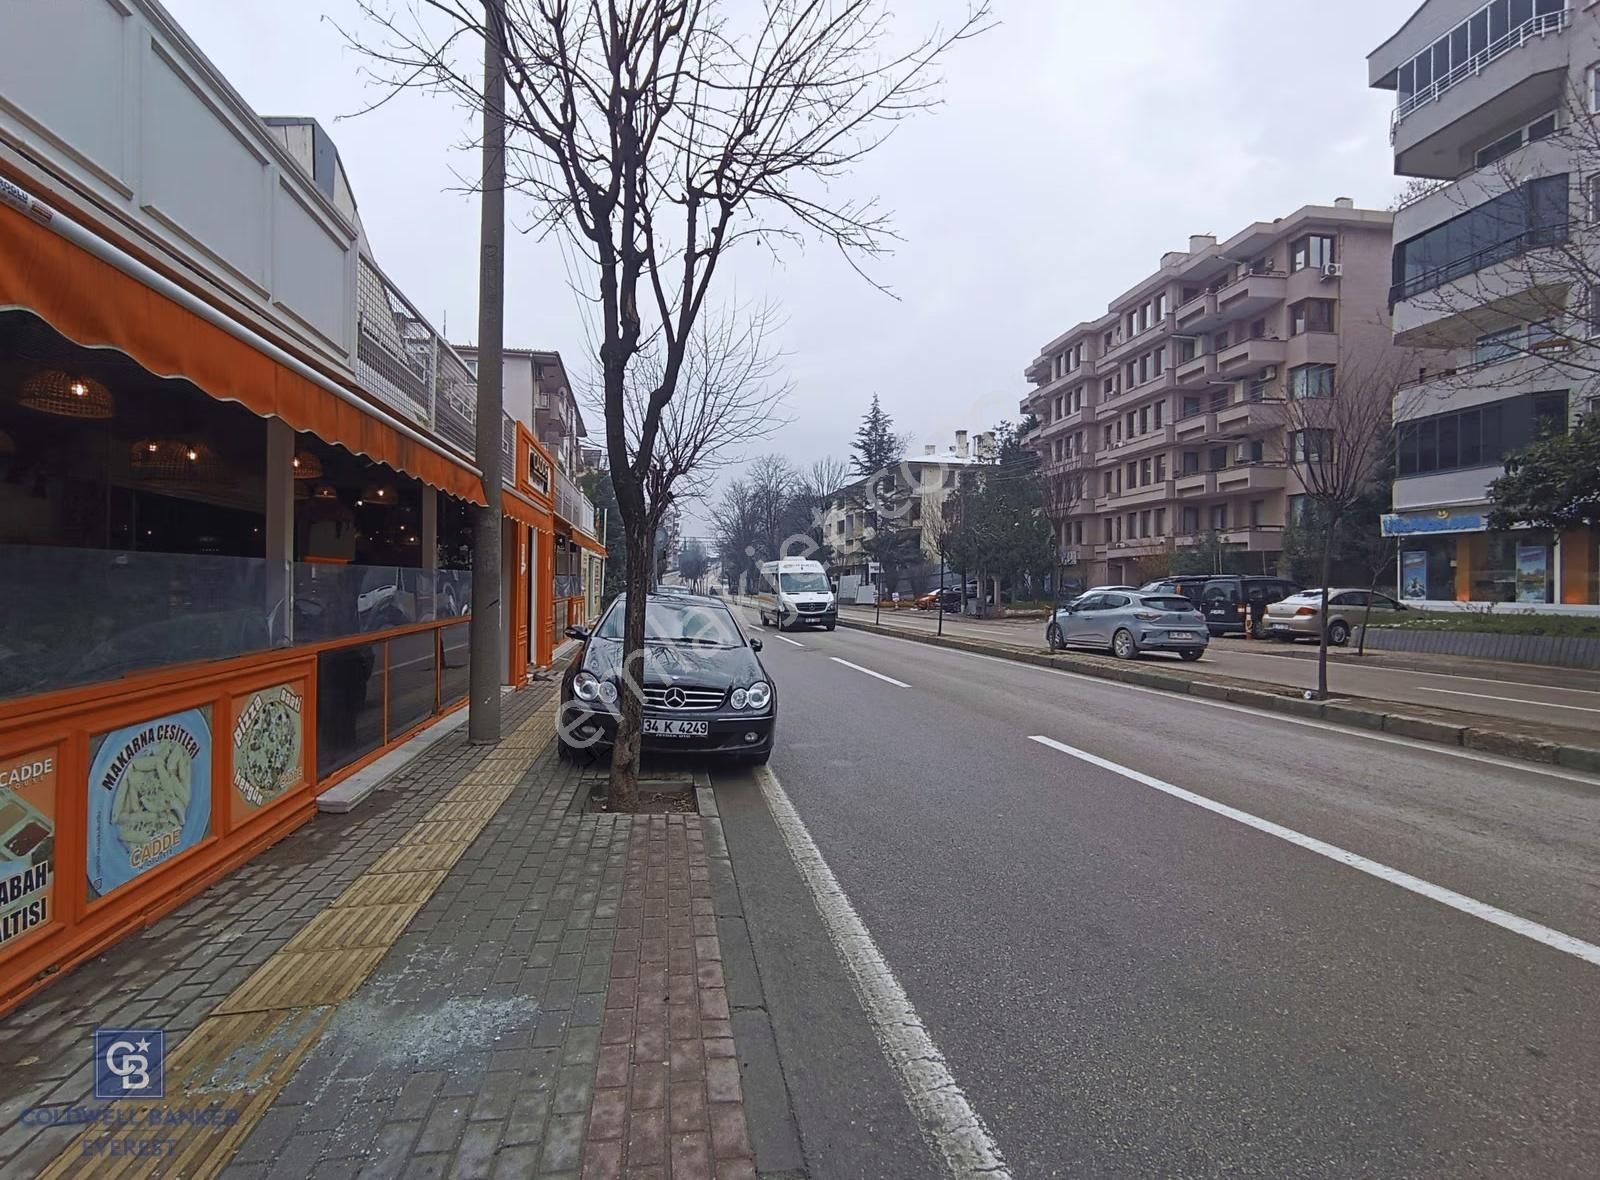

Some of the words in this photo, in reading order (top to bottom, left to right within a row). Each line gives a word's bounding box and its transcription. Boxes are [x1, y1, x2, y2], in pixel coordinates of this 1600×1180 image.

[645, 720, 659, 732] 34
[664, 721, 673, 732] K
[679, 722, 707, 734] 4249
[102, 728, 155, 790] MAKARNA
[131, 828, 182, 868] CADDE
[0, 896, 47, 943] LTISI
